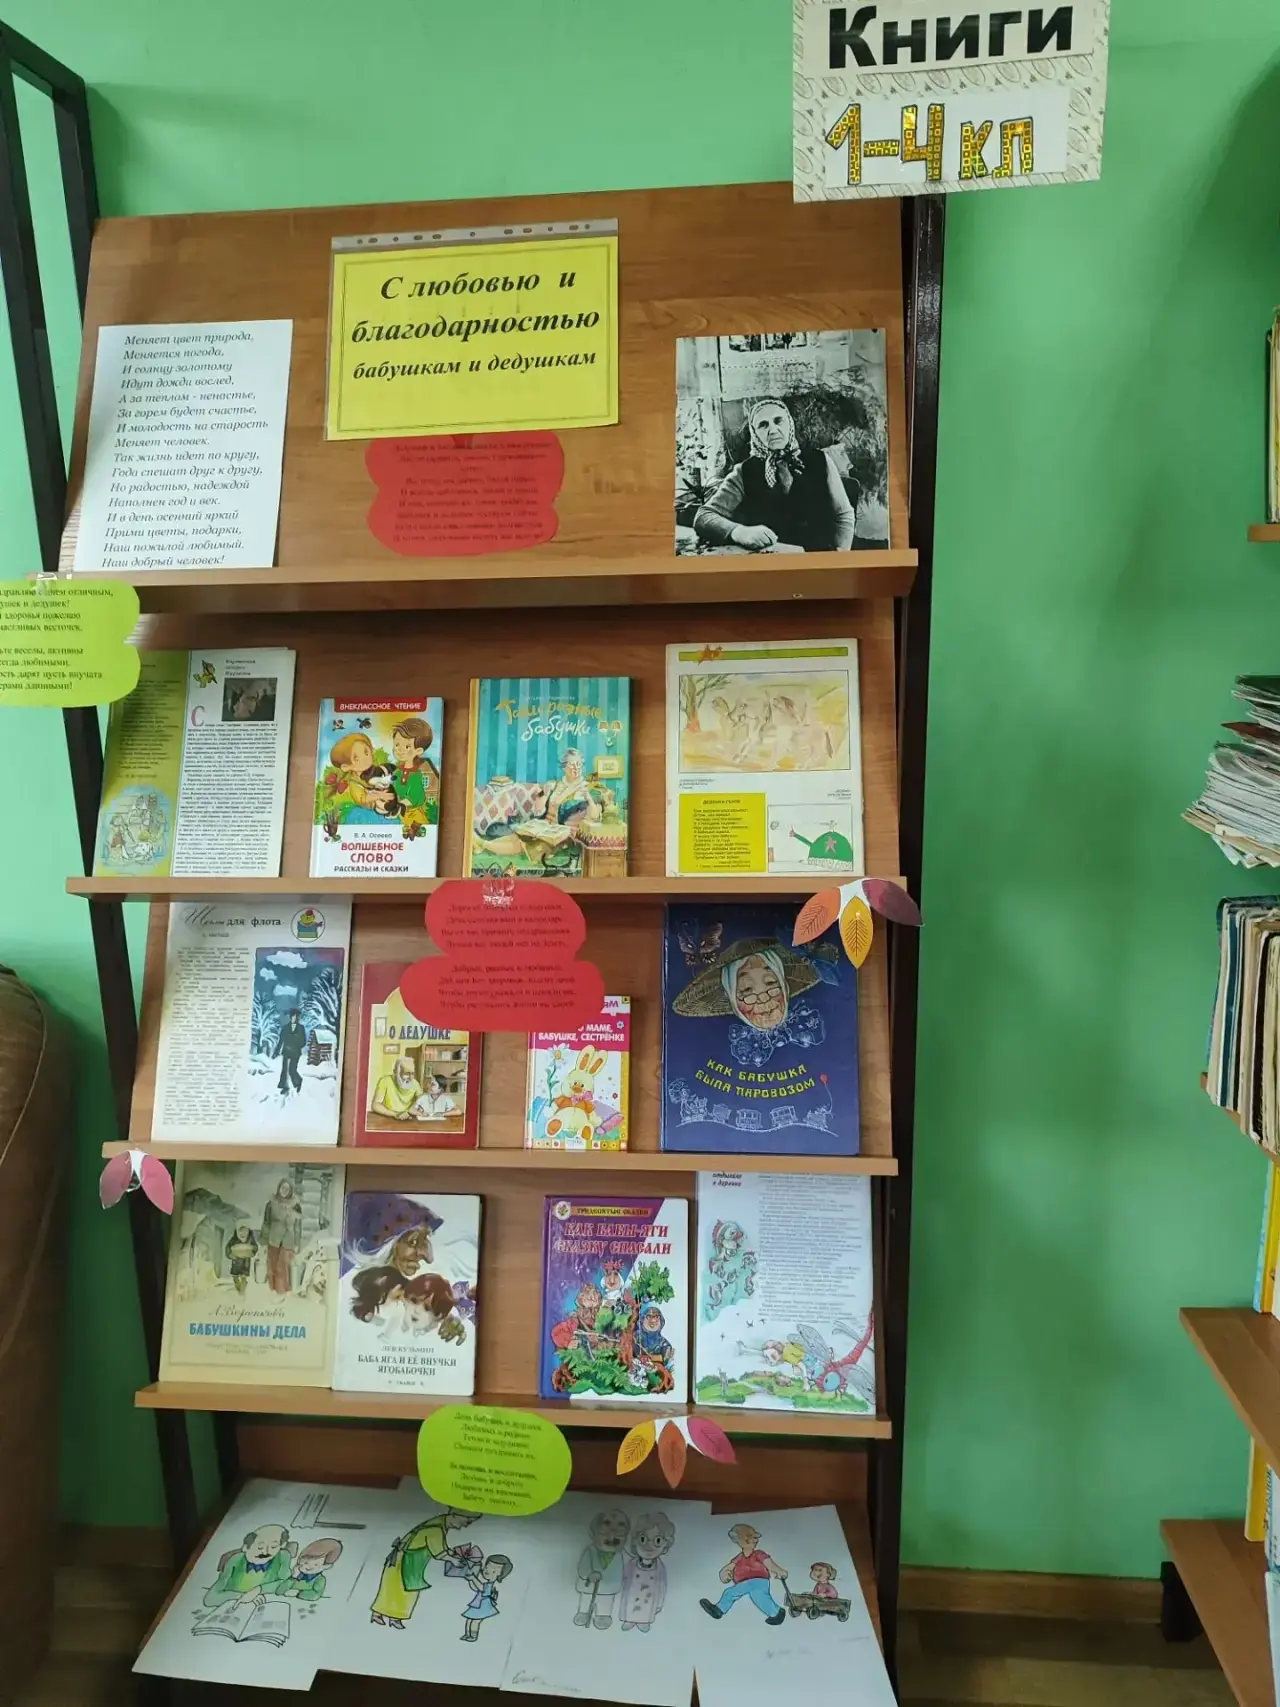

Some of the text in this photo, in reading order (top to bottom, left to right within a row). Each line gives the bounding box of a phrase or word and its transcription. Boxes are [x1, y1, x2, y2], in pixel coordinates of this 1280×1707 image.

[829, 5, 1073, 69] Книги
[825, 103, 945, 185] 1-4
[381, 270, 576, 299] С любовью и
[351, 310, 600, 344] благодарностью
[124, 335, 170, 345] Меняет
[173, 335, 201, 345] цвет
[123, 350, 181, 360] Меняется
[122, 363, 233, 375] И солнцу золотому
[353, 351, 596, 382] бабушкам и дедушкам
[121, 379, 153, 390] Идут
[156, 379, 192, 388] дожди
[119, 395, 127, 403] А
[145, 393, 189, 403] теплом
[118, 407, 257, 420] За горем будет счастье,
[116, 424, 126, 433] И
[128, 422, 191, 433] молодость
[114, 438, 209, 448] Меняет человек.
[114, 451, 259, 463] Так жизнь идет по кругу,
[141, 467, 186, 478] спешат
[189, 466, 215, 478] друг
[218, 468, 224, 476] к
[227, 466, 263, 477] другу,
[111, 480, 250, 494] Но радостью, надеждой
[109, 499, 165, 508] Наполнен
[168, 498, 186, 508] год
[199, 498, 220, 506] век.
[107, 514, 117, 522] И
[129, 514, 153, 523] день
[156, 511, 202, 521] осенний
[204, 510, 239, 521] яркий
[105, 527, 242, 539] Прими цветы, подарки,
[104, 544, 130, 553] Наш
[133, 542, 184, 553] пожилой
[102, 555, 225, 568] Наш добрый человек!
[521, 715, 590, 742] бабушки
[351, 853, 393, 863] СЛОВО
[251, 917, 282, 927] флота
[389, 1025, 451, 1040] О ДЕДУШКЕ
[586, 1024, 613, 1032] МАМЕ,
[539, 1032, 578, 1042] БАБУШКЕ,
[706, 1059, 807, 1083] КАК БАБУШКА
[695, 1070, 815, 1098] БЫЛА ПАРОВОЗОМ
[564, 1223, 668, 1237] КАК БАБЫ-ЯГИ
[556, 1239, 671, 1257] СКАЗКУ СПАСАЛИ
[189, 1323, 306, 1340] БАБУШКИНЫ ДЕЛА
[358, 1354, 379, 1362] БАБА
[381, 1356, 397, 1364] ЯГА
[400, 1356, 405, 1364] И
[420, 1358, 456, 1366] ВНУЧКИ
[378, 1366, 435, 1376] ЯГОБАБОЧКИ
